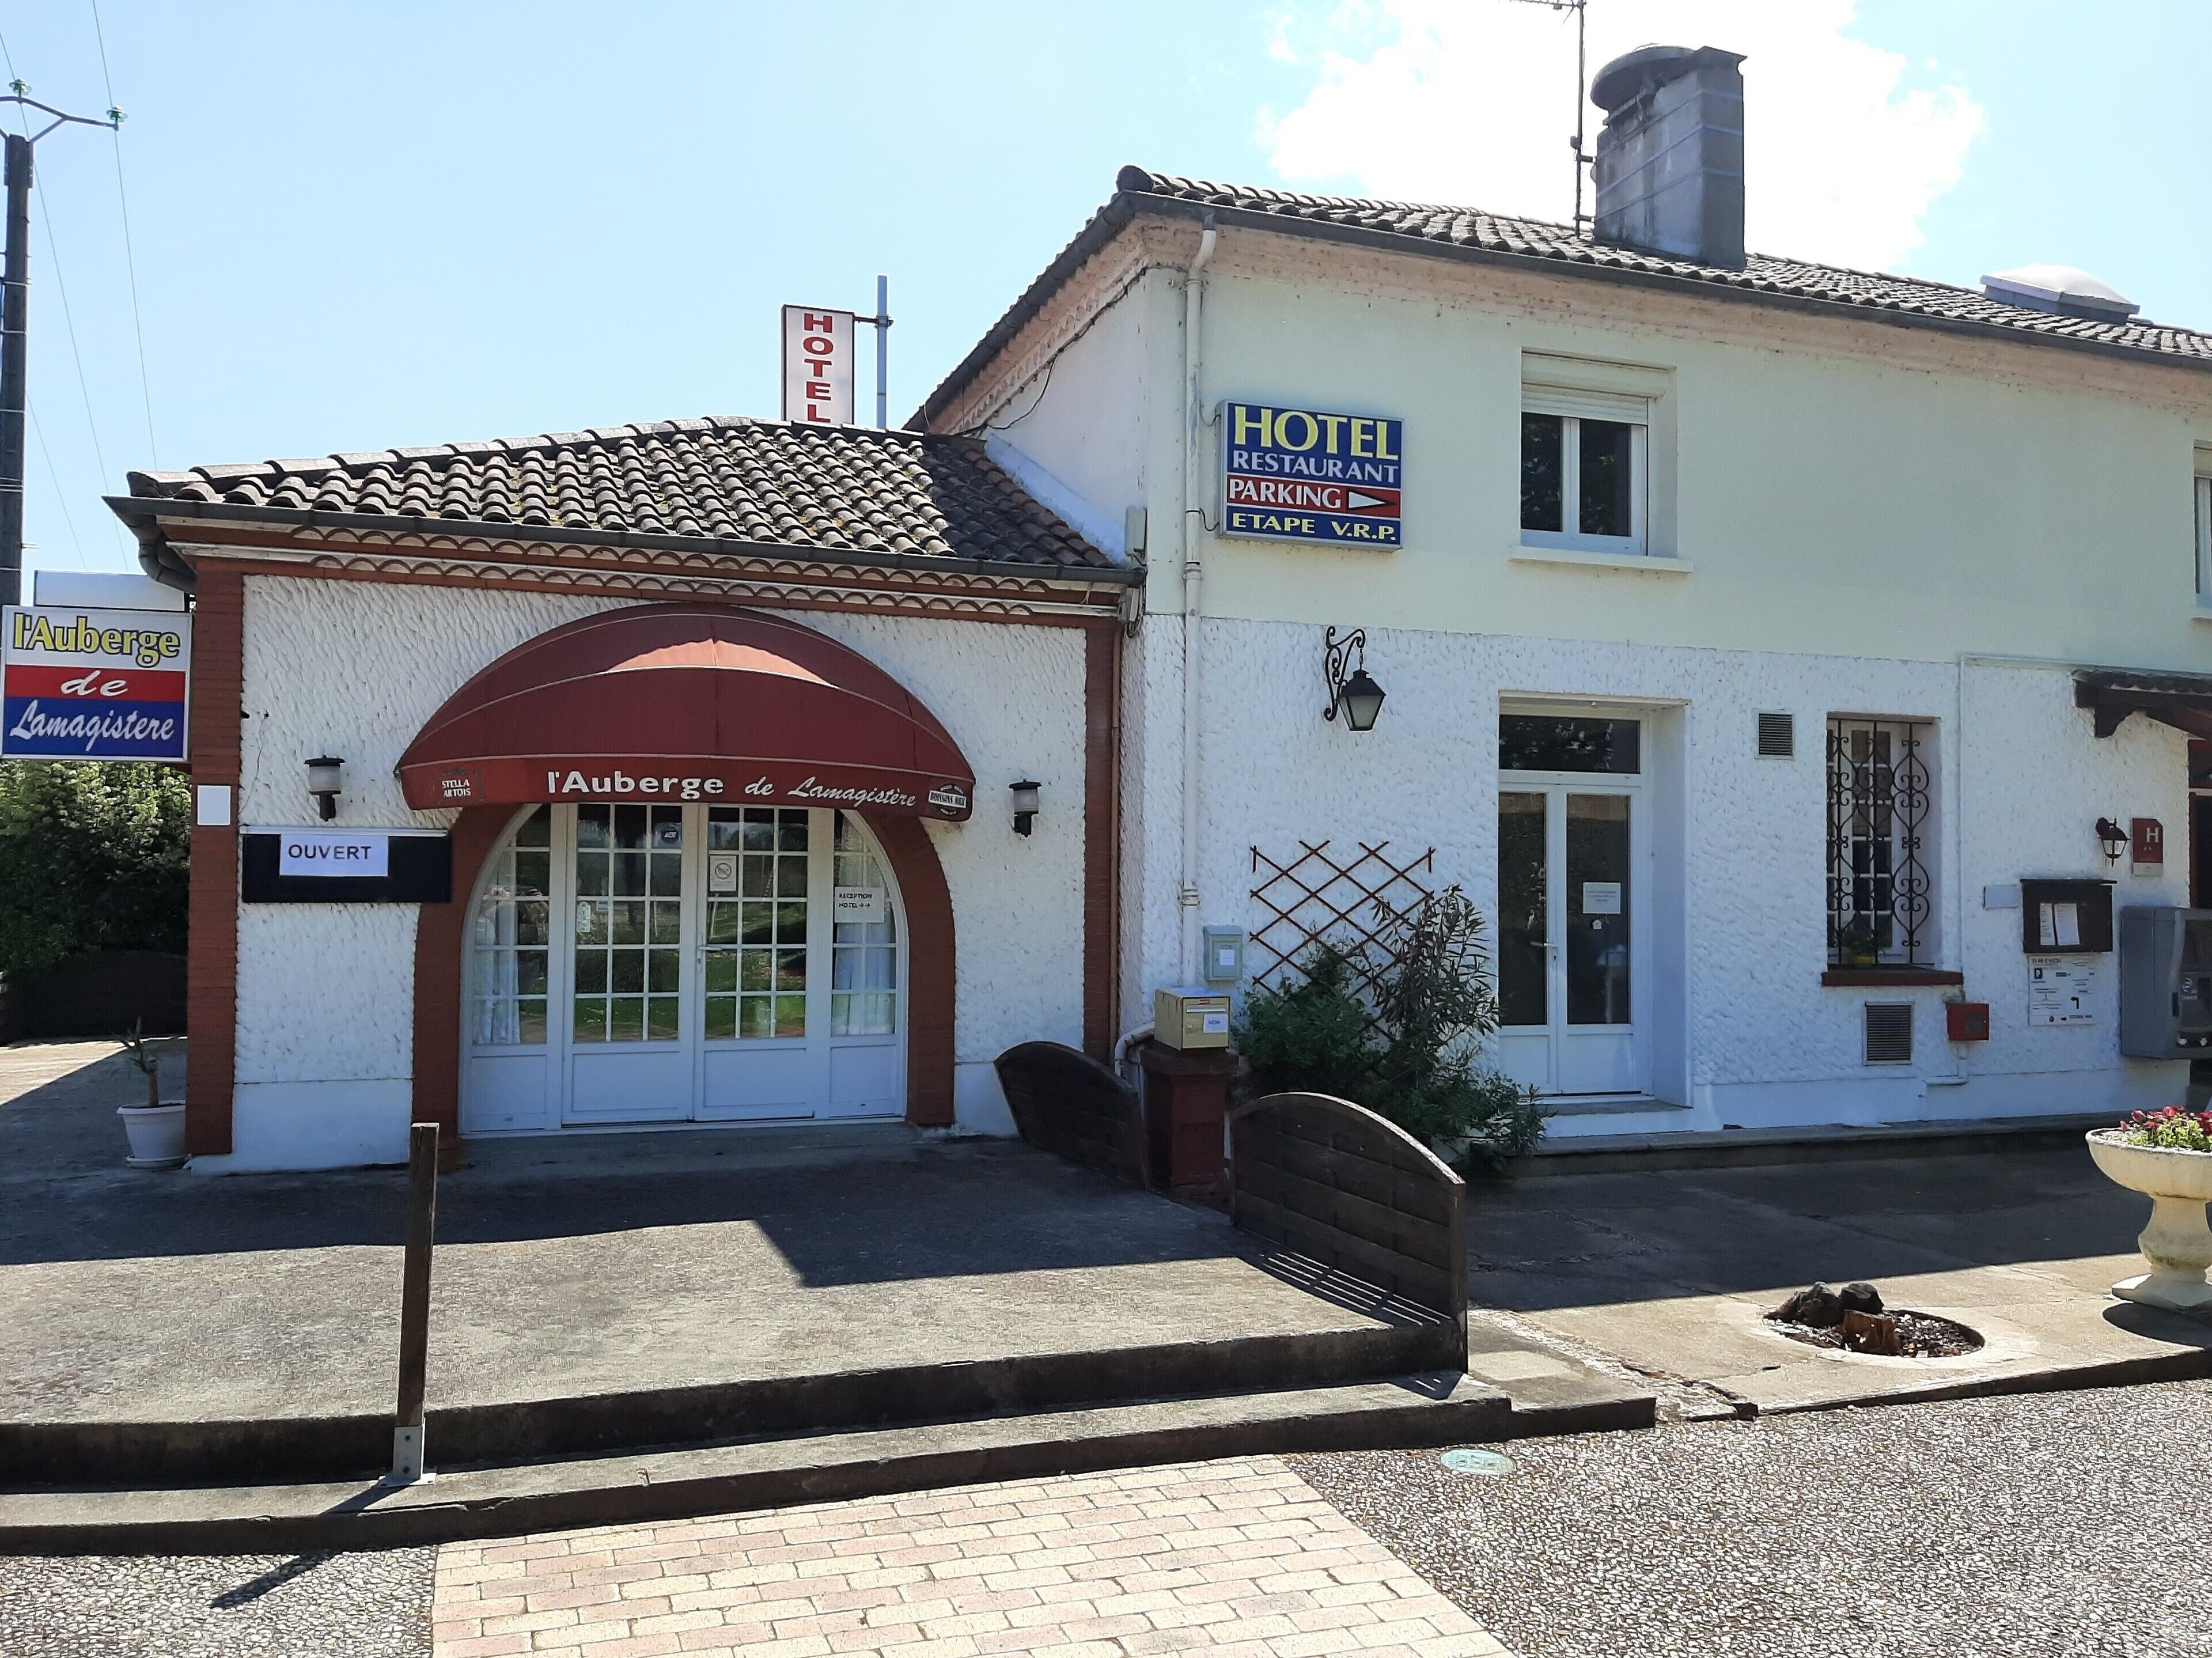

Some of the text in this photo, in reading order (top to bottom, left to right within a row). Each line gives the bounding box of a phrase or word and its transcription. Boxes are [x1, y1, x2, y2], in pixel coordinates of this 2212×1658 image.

[803, 313, 834, 423] HOTEL
[1234, 405, 1399, 461] HOTEL
[1233, 450, 1399, 483] RESTAURANT
[1229, 478, 1341, 509] PARKING
[1232, 512, 1316, 533] ETAPE
[13, 612, 181, 668] l'Auberge
[60, 669, 128, 696] de
[441, 779, 470, 789] STELLA
[443, 788, 472, 798] ARTOIS
[547, 770, 724, 800] l'Auberge
[744, 776, 775, 796] de
[2145, 827, 2160, 843] H
[287, 844, 372, 860] OUVERT
